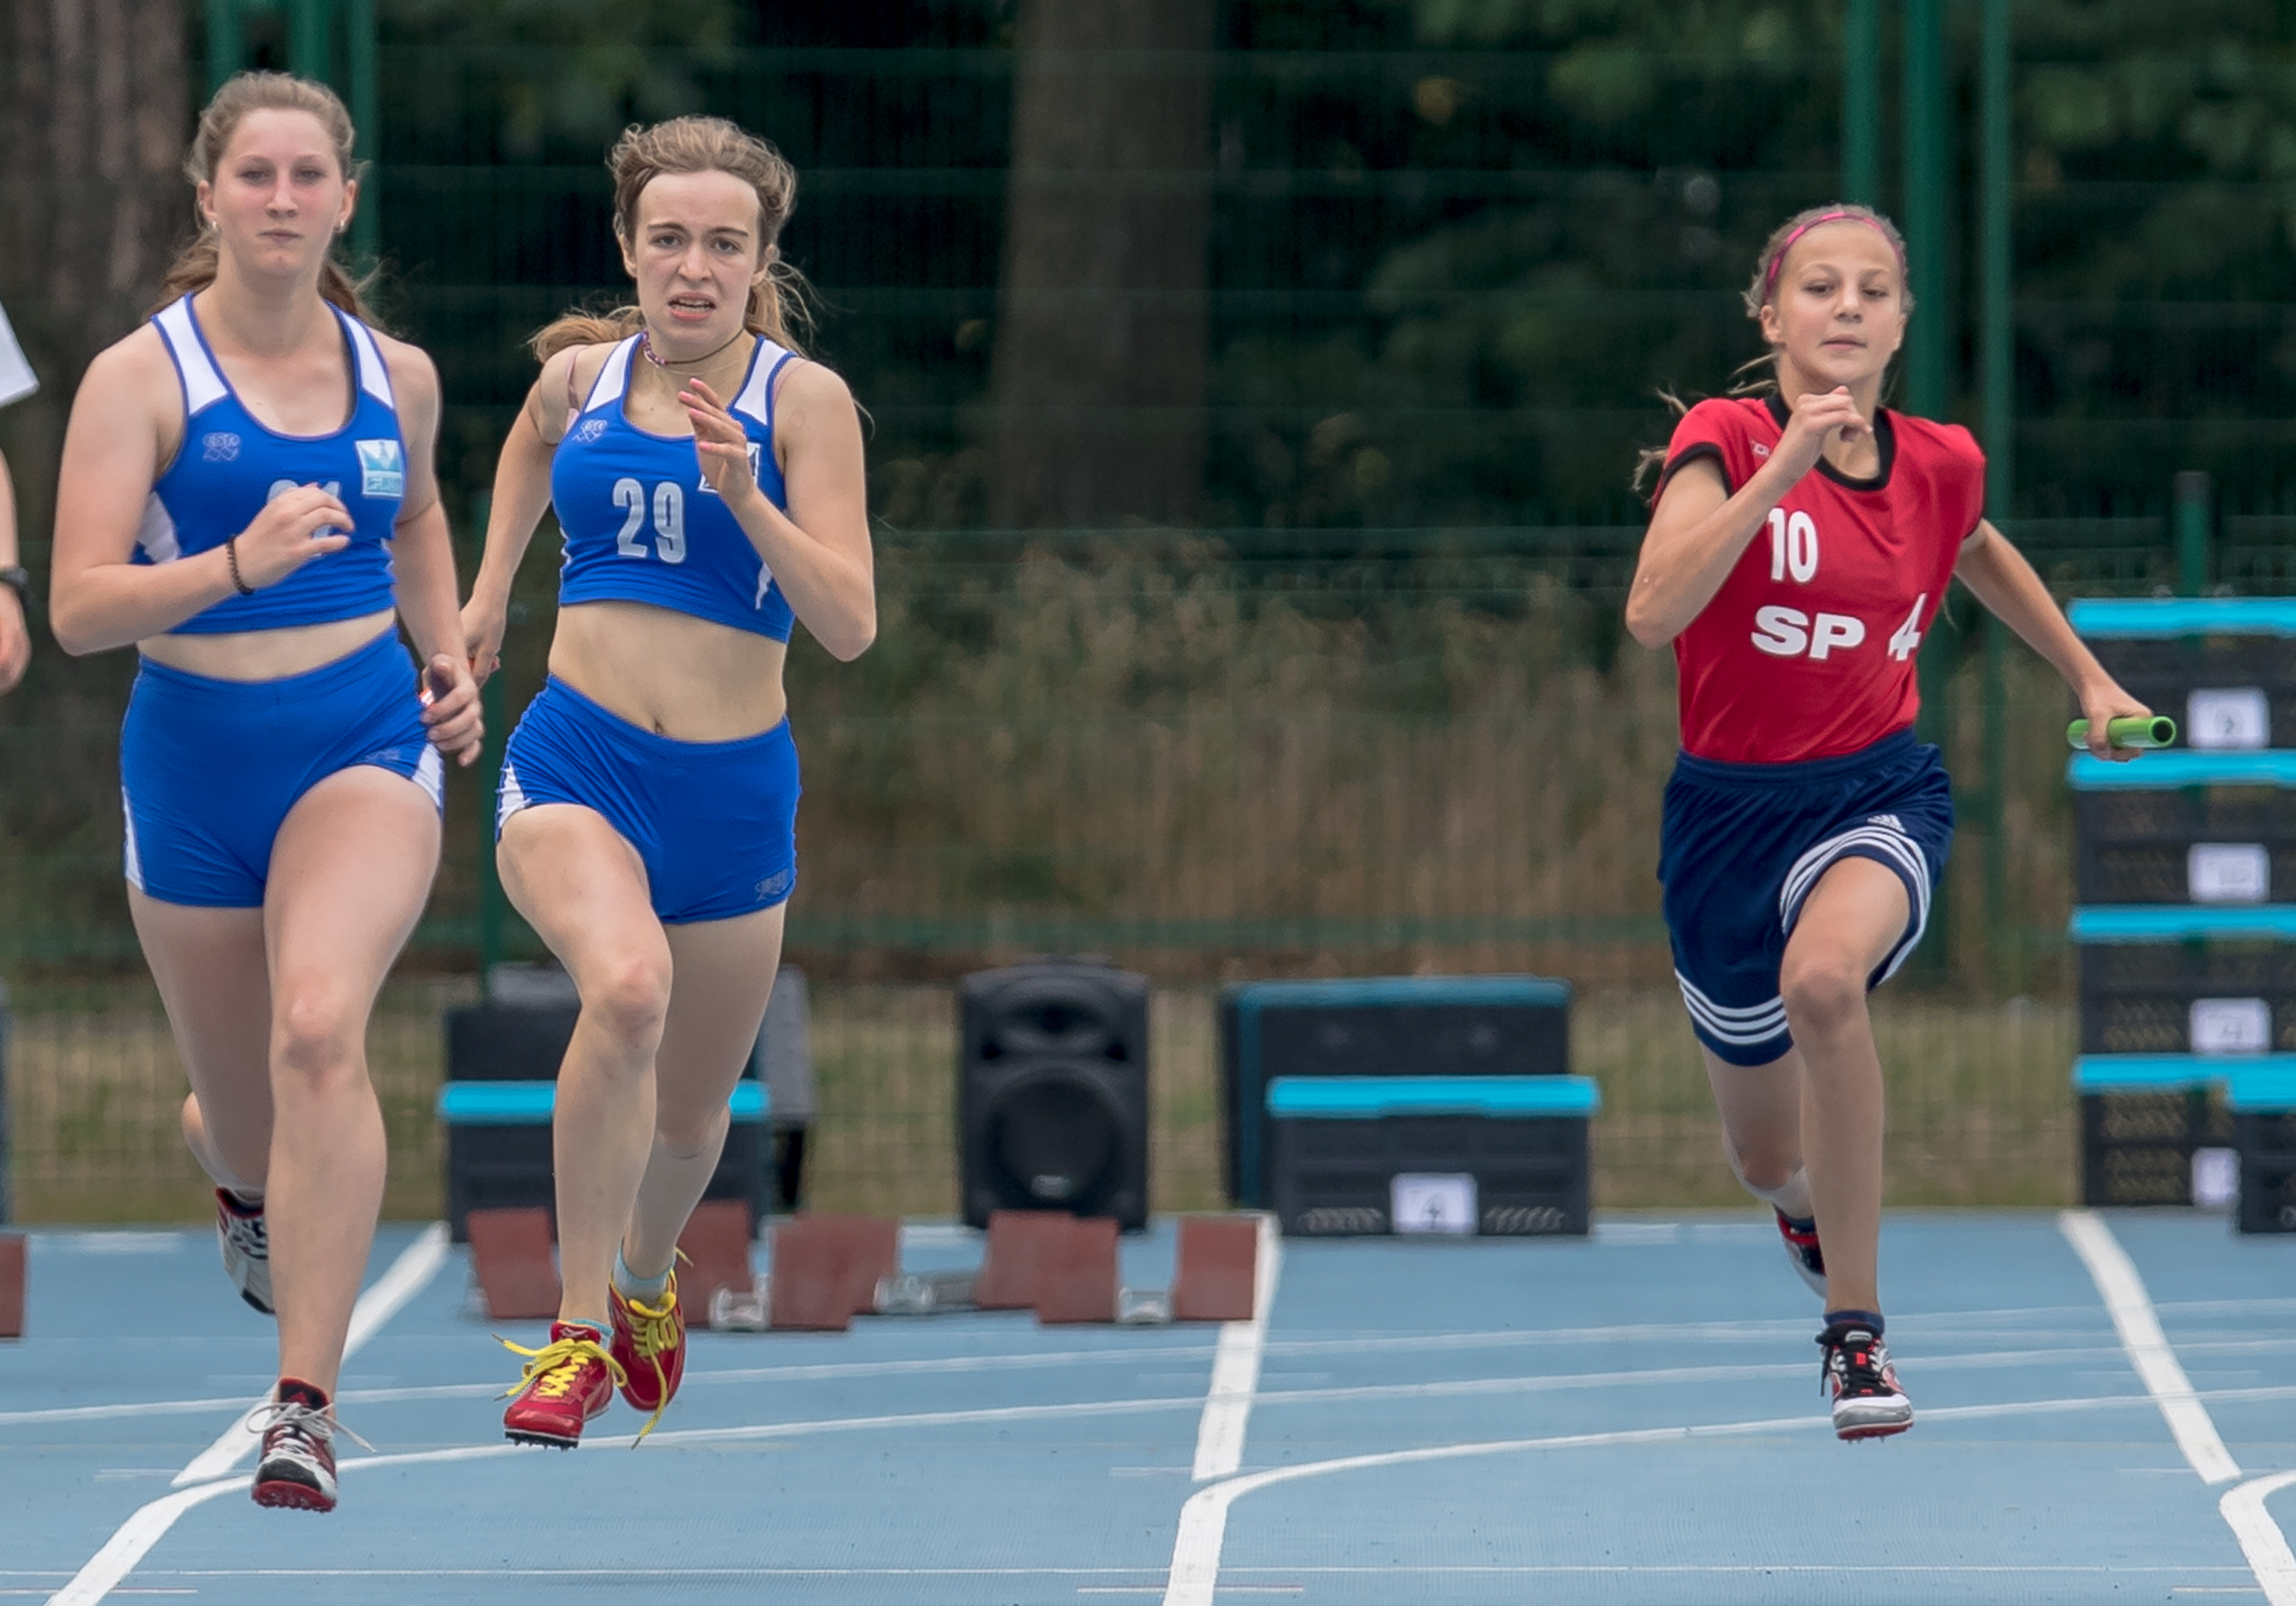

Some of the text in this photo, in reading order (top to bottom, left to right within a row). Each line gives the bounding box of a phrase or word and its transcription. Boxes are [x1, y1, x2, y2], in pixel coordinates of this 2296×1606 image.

[612, 477, 686, 564] 29
[1769, 507, 1819, 584] 10
[1750, 593, 1927, 661] SP 4
